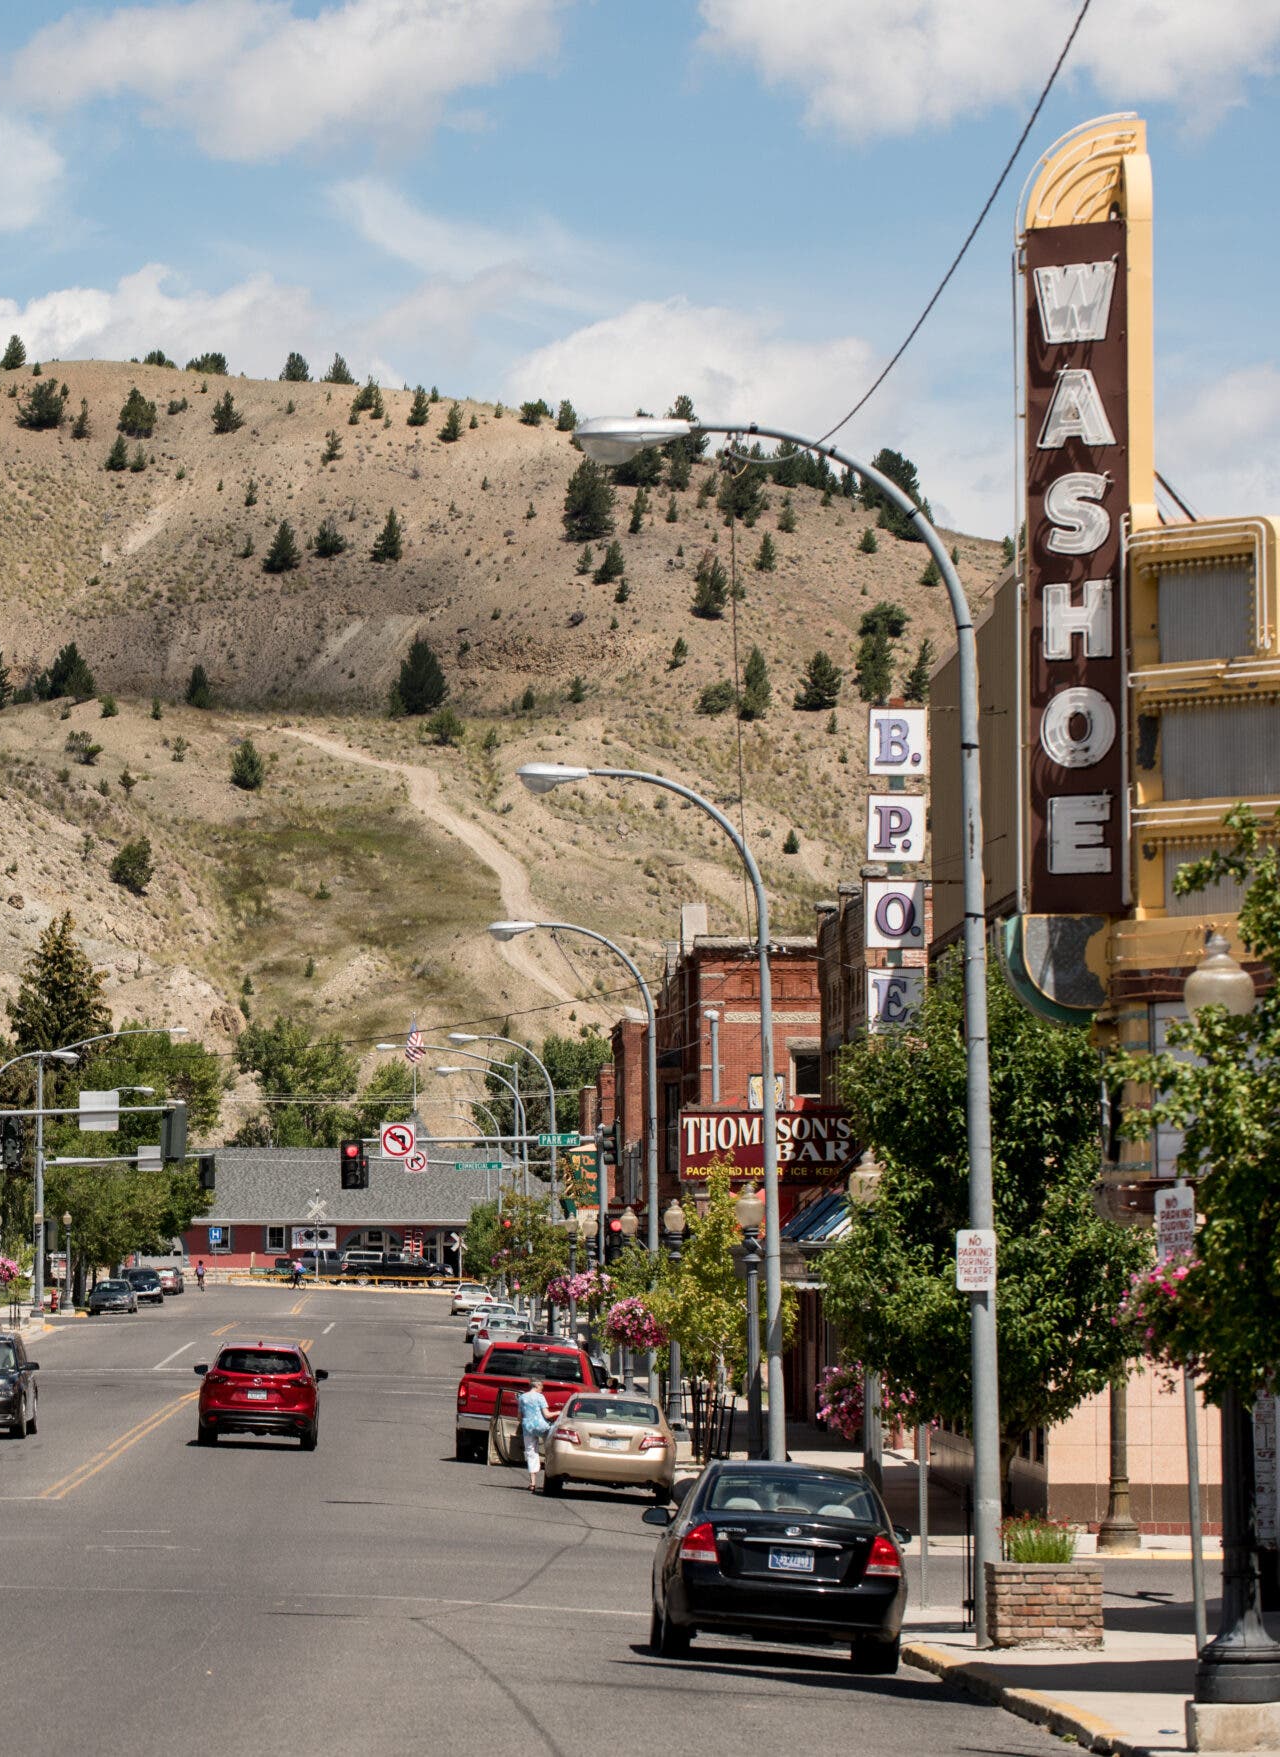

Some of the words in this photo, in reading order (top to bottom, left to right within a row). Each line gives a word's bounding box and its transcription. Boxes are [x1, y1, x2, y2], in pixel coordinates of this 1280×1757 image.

[1033, 261, 1117, 875] WASHOE
[541, 1136, 562, 1145] PARK
[566, 1137, 577, 1145] AVE
[682, 1116, 851, 1157] THOMSON'S
[776, 1140, 851, 1162] BAR
[458, 1162, 489, 1170] COMMERCIAL
[791, 1167, 808, 1176] ICE
[1165, 1197, 1178, 1209] NO
[1160, 1208, 1193, 1220] PARKING
[1160, 1220, 1190, 1232] DURING
[211, 1230, 220, 1239] H
[969, 1236, 982, 1247] NO
[958, 1248, 993, 1258] PARKING
[958, 1257, 990, 1266] DURING
[959, 1266, 994, 1275] THEATRE
